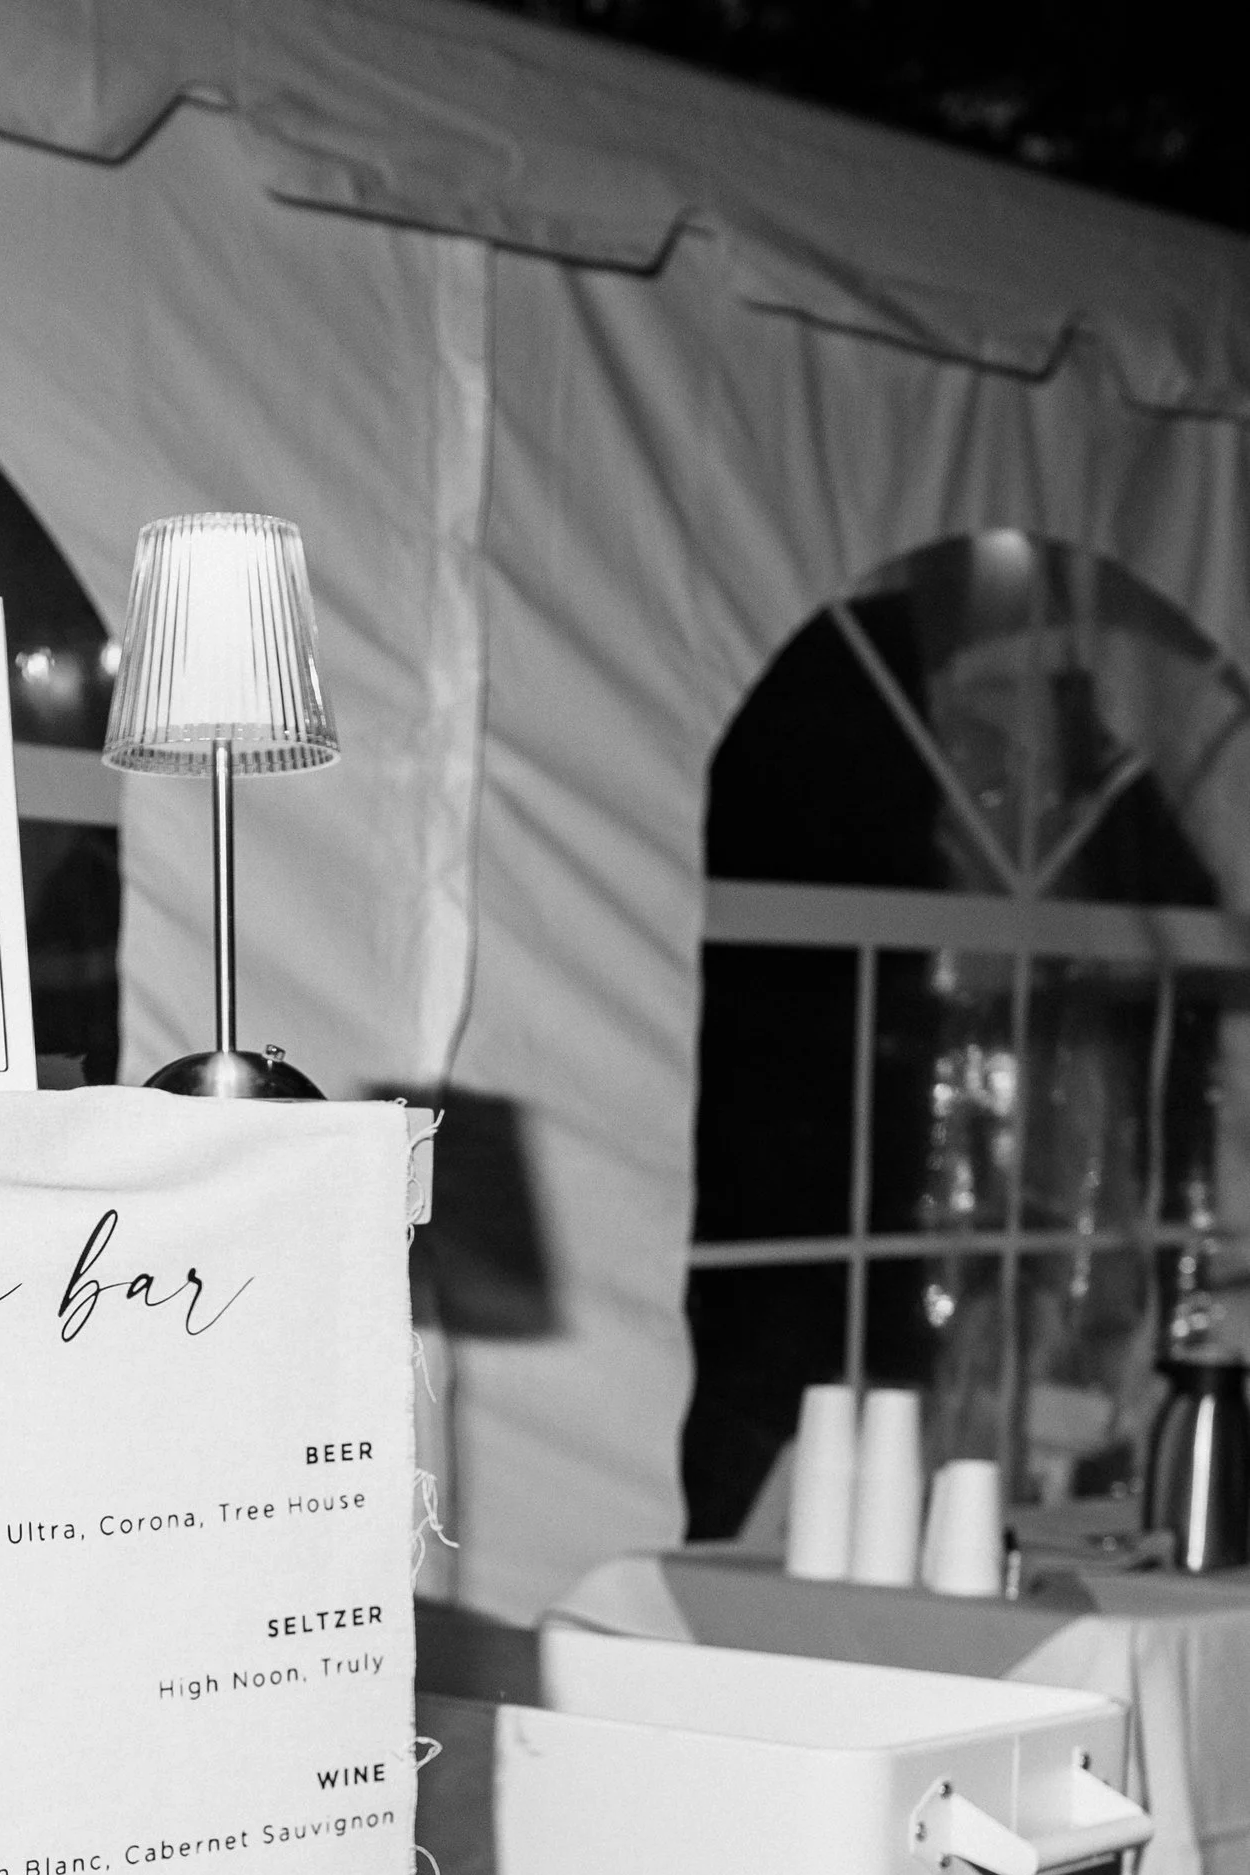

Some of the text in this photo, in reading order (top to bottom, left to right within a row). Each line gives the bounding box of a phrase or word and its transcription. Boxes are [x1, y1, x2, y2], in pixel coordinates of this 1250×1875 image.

[57, 1208, 255, 1344] bar
[305, 1441, 373, 1466] BEER
[7, 1521, 85, 1545] Ultra,
[99, 1512, 204, 1537] Corona,
[218, 1502, 275, 1523] Tree
[288, 1493, 366, 1514] House
[267, 1605, 382, 1639] SELTZER
[159, 1653, 384, 1701] High Noon, Truly
[316, 1762, 386, 1791] WINE
[124, 1830, 248, 1865] Cabernet
[262, 1810, 394, 1845] Sauvignon
